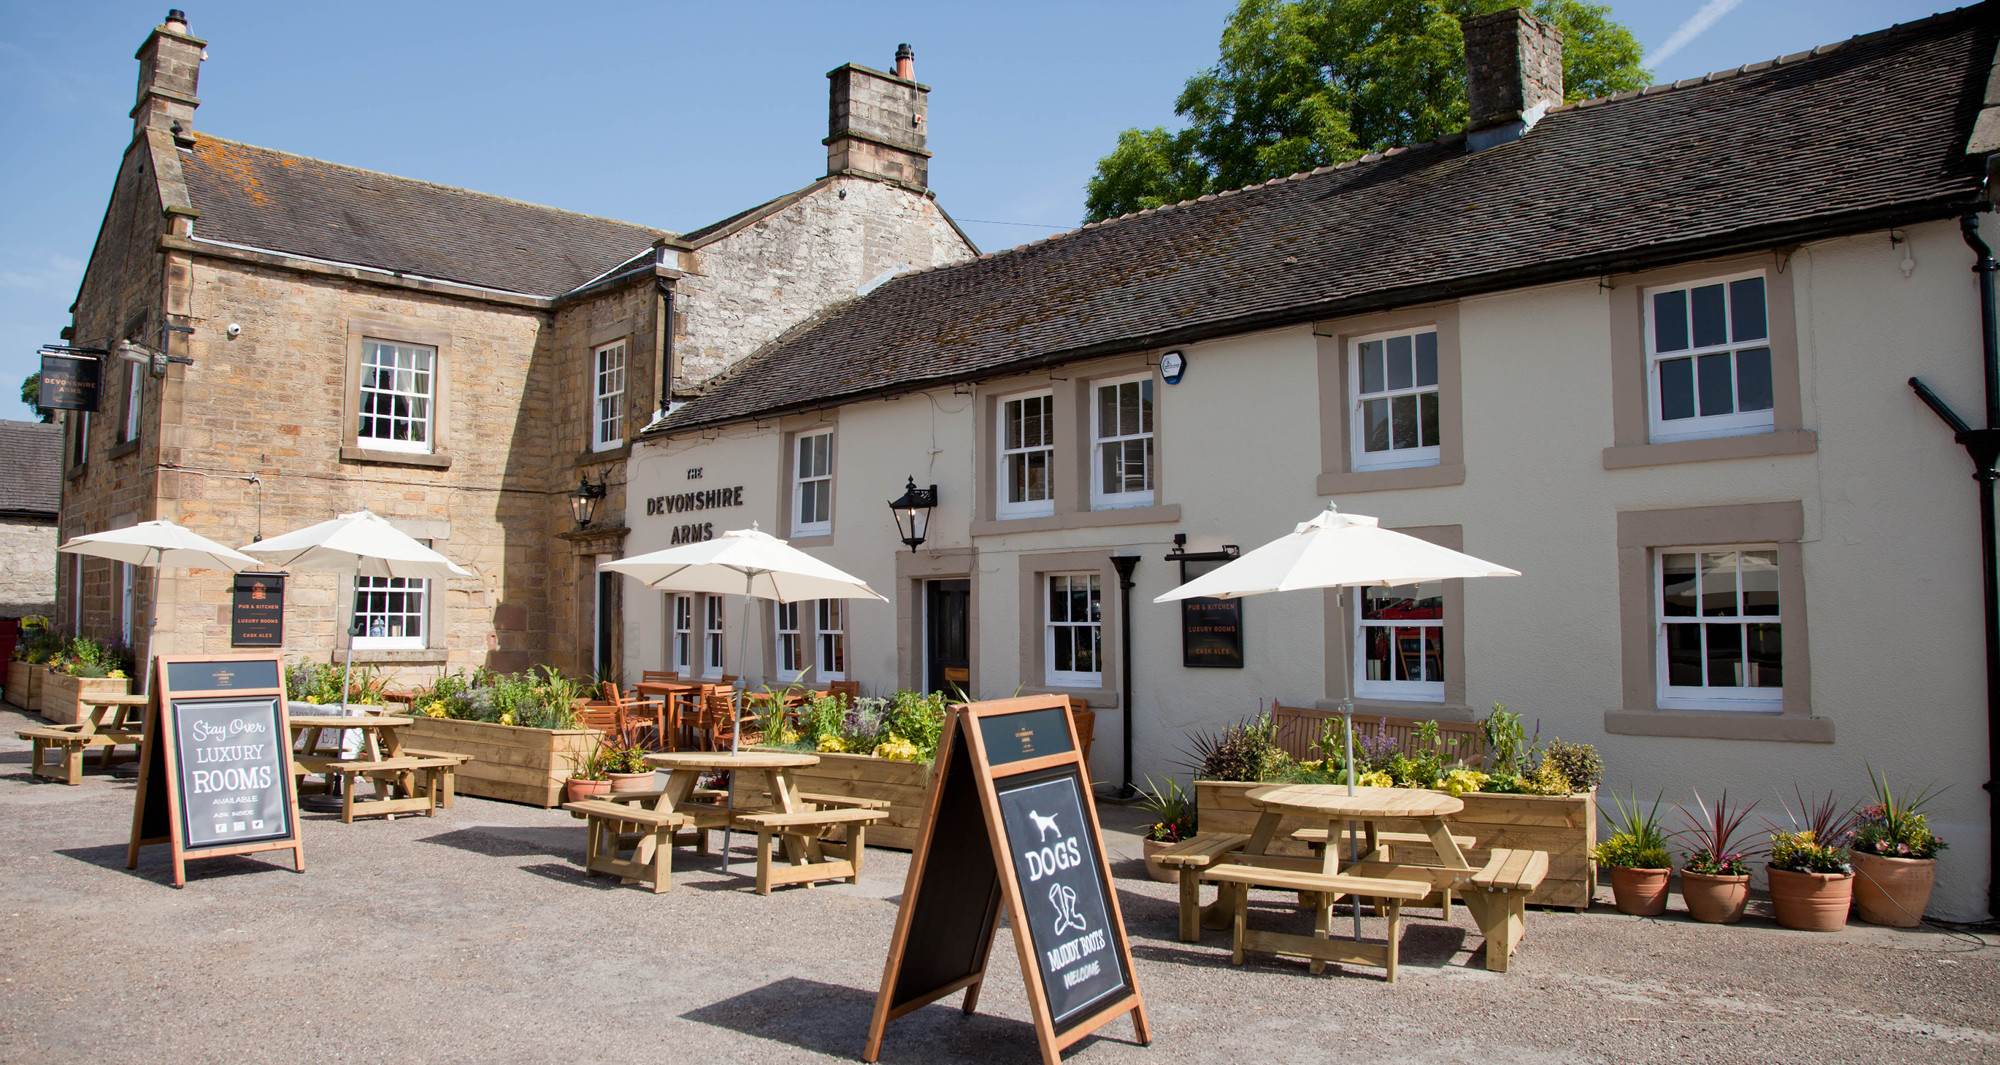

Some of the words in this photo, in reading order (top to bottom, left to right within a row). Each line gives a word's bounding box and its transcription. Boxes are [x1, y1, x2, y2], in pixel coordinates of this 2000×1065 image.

[44, 378, 96, 388] DEVONSHIRE
[686, 467, 703, 480] THE
[646, 485, 744, 516] DEVONSHIRE
[670, 522, 713, 545] ARMS
[1214, 625, 1236, 633] ROOMS
[192, 719, 226, 742] Stay
[229, 718, 266, 735] Over
[196, 744, 265, 763] LUXURY
[192, 765, 272, 794] ROOMS
[212, 795, 259, 805] AVAILABLE
[213, 810, 231, 818] ASK
[231, 809, 255, 817] INSIDE
[1025, 836, 1082, 882] DOGS
[1047, 939, 1082, 973] MUDDY
[1080, 929, 1106, 957] BOOTS
[1063, 960, 1101, 990] WELCOME
